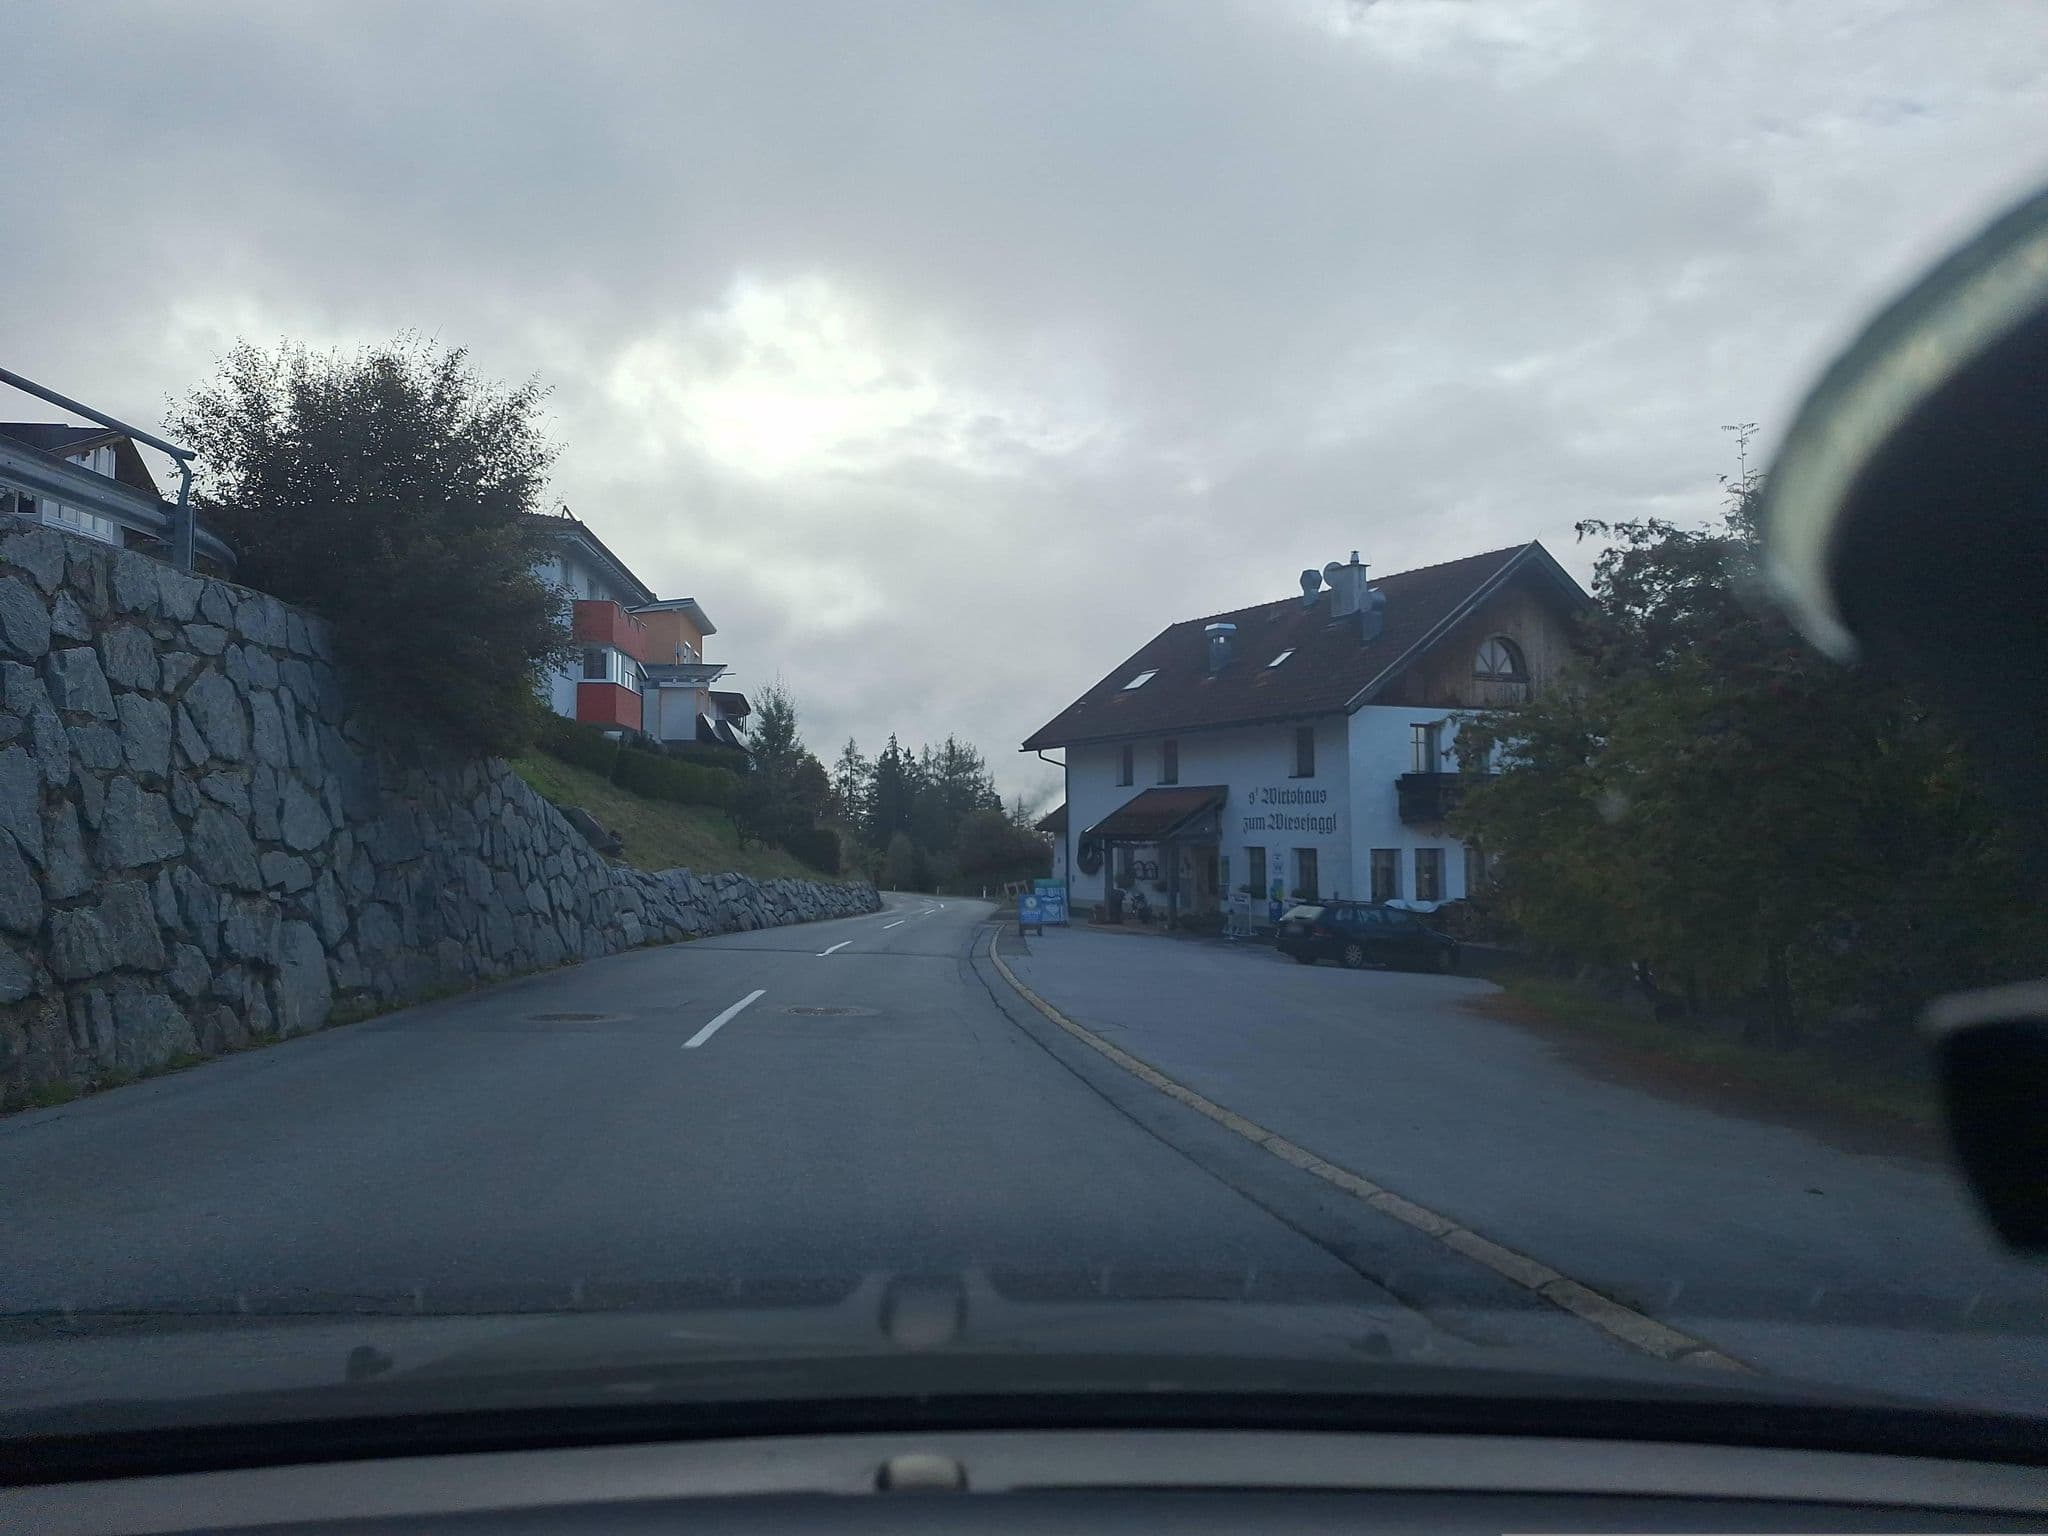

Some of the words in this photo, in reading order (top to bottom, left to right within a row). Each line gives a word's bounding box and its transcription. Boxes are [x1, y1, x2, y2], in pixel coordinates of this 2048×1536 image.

[1261, 787, 1327, 806] Wirtshaus
[1242, 816, 1266, 835] zum
[1267, 812, 1337, 834] Wiesejaggl
